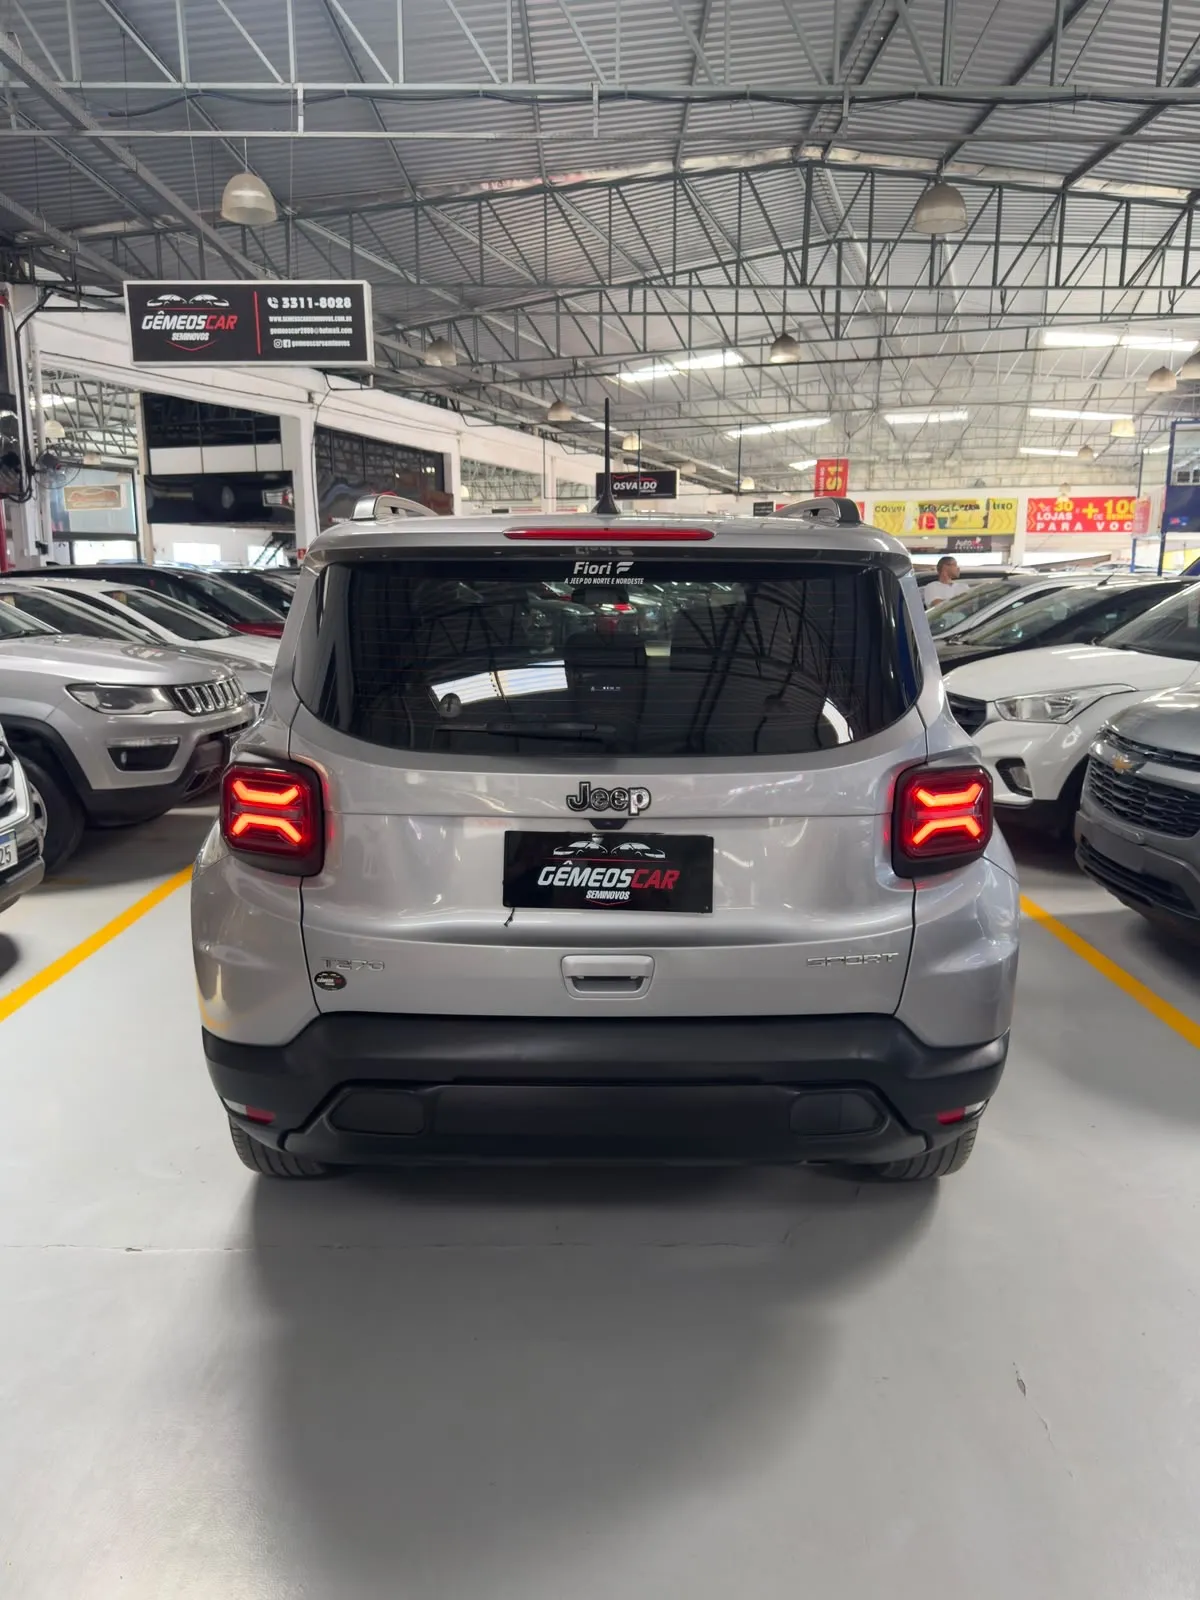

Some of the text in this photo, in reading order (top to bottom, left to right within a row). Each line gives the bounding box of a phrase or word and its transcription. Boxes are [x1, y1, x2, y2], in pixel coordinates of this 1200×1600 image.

[281, 296, 352, 309] 3311-8028
[141, 310, 238, 331] GÊMEOSCAR
[171, 332, 210, 341] SEMINOVOS
[613, 481, 658, 491] OSVALDO
[1036, 512, 1073, 521] LOJAS
[1036, 521, 1134, 531] PARA VOC
[573, 561, 613, 575] Fiori
[566, 781, 652, 816] Jeep
[537, 860, 681, 890] GÊMEOSCAR
[585, 889, 631, 901] SEMINOVOS
[320, 956, 385, 971] T270
[806, 952, 899, 968] SPORT
